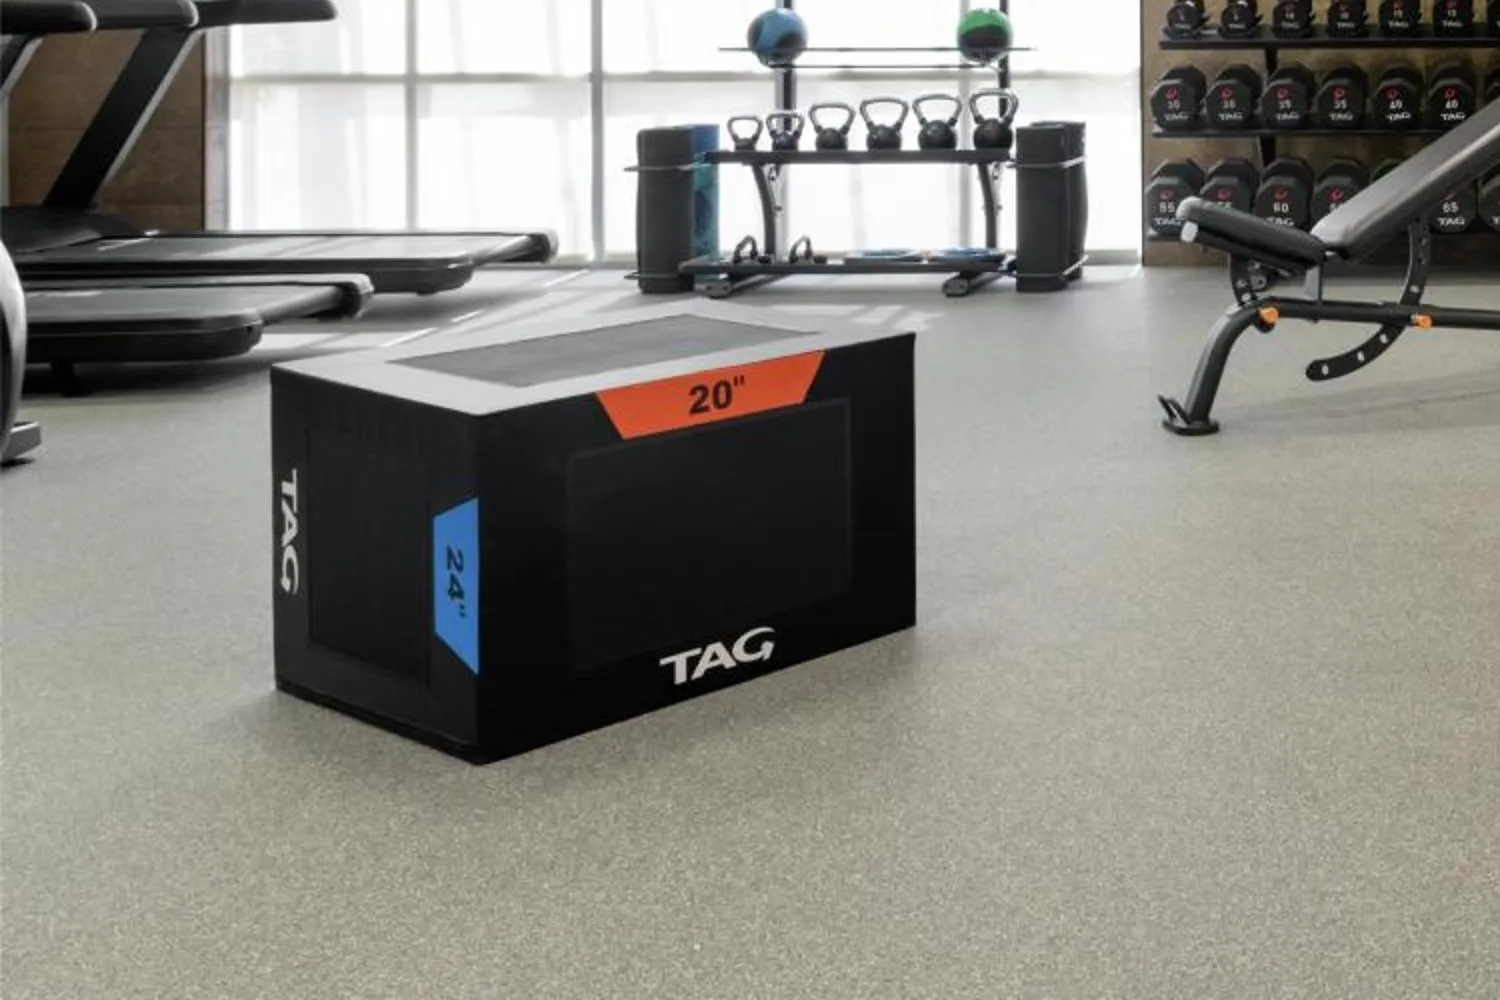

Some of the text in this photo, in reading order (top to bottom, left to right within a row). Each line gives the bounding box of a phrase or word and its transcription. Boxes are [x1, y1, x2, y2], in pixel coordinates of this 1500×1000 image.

[688, 375, 746, 414] 20"
[279, 468, 300, 595] TAG
[445, 548, 466, 619] 24"
[659, 626, 777, 685] TAG
